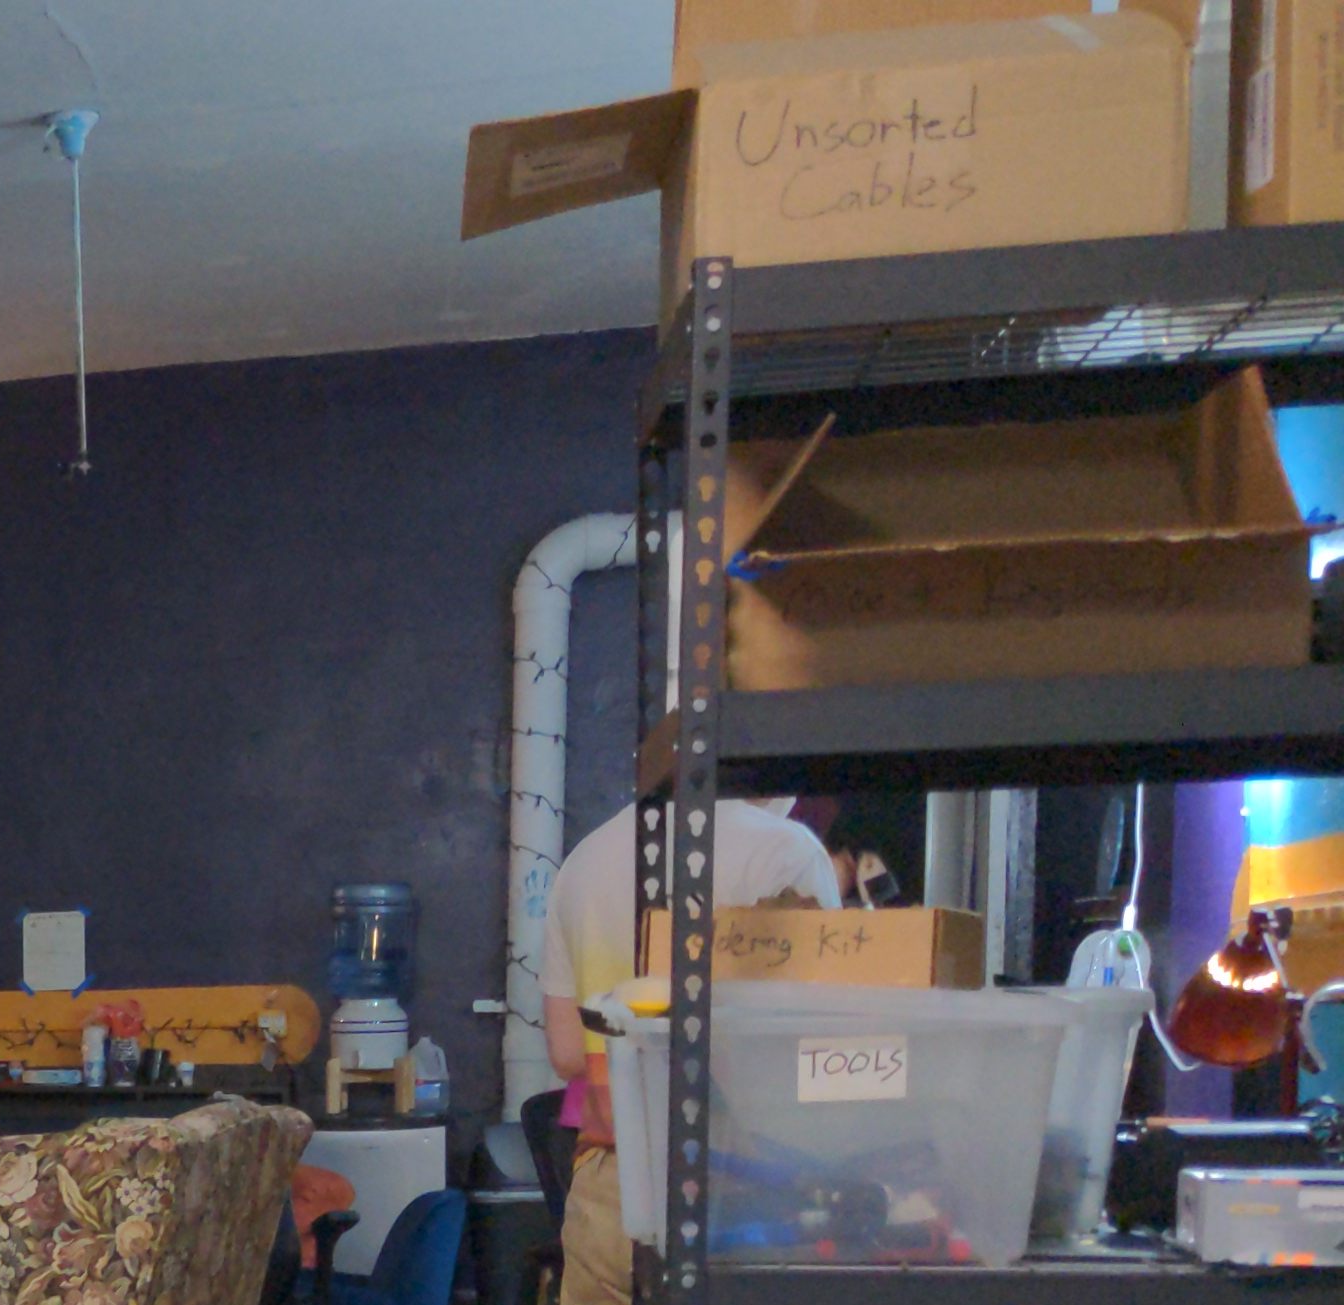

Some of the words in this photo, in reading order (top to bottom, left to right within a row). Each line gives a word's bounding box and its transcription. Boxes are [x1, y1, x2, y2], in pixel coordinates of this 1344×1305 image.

[736, 84, 977, 166] Unsorted
[780, 152, 977, 220] Cables
[818, 924, 872, 957] Kit
[801, 1049, 903, 1082] TOOLS
